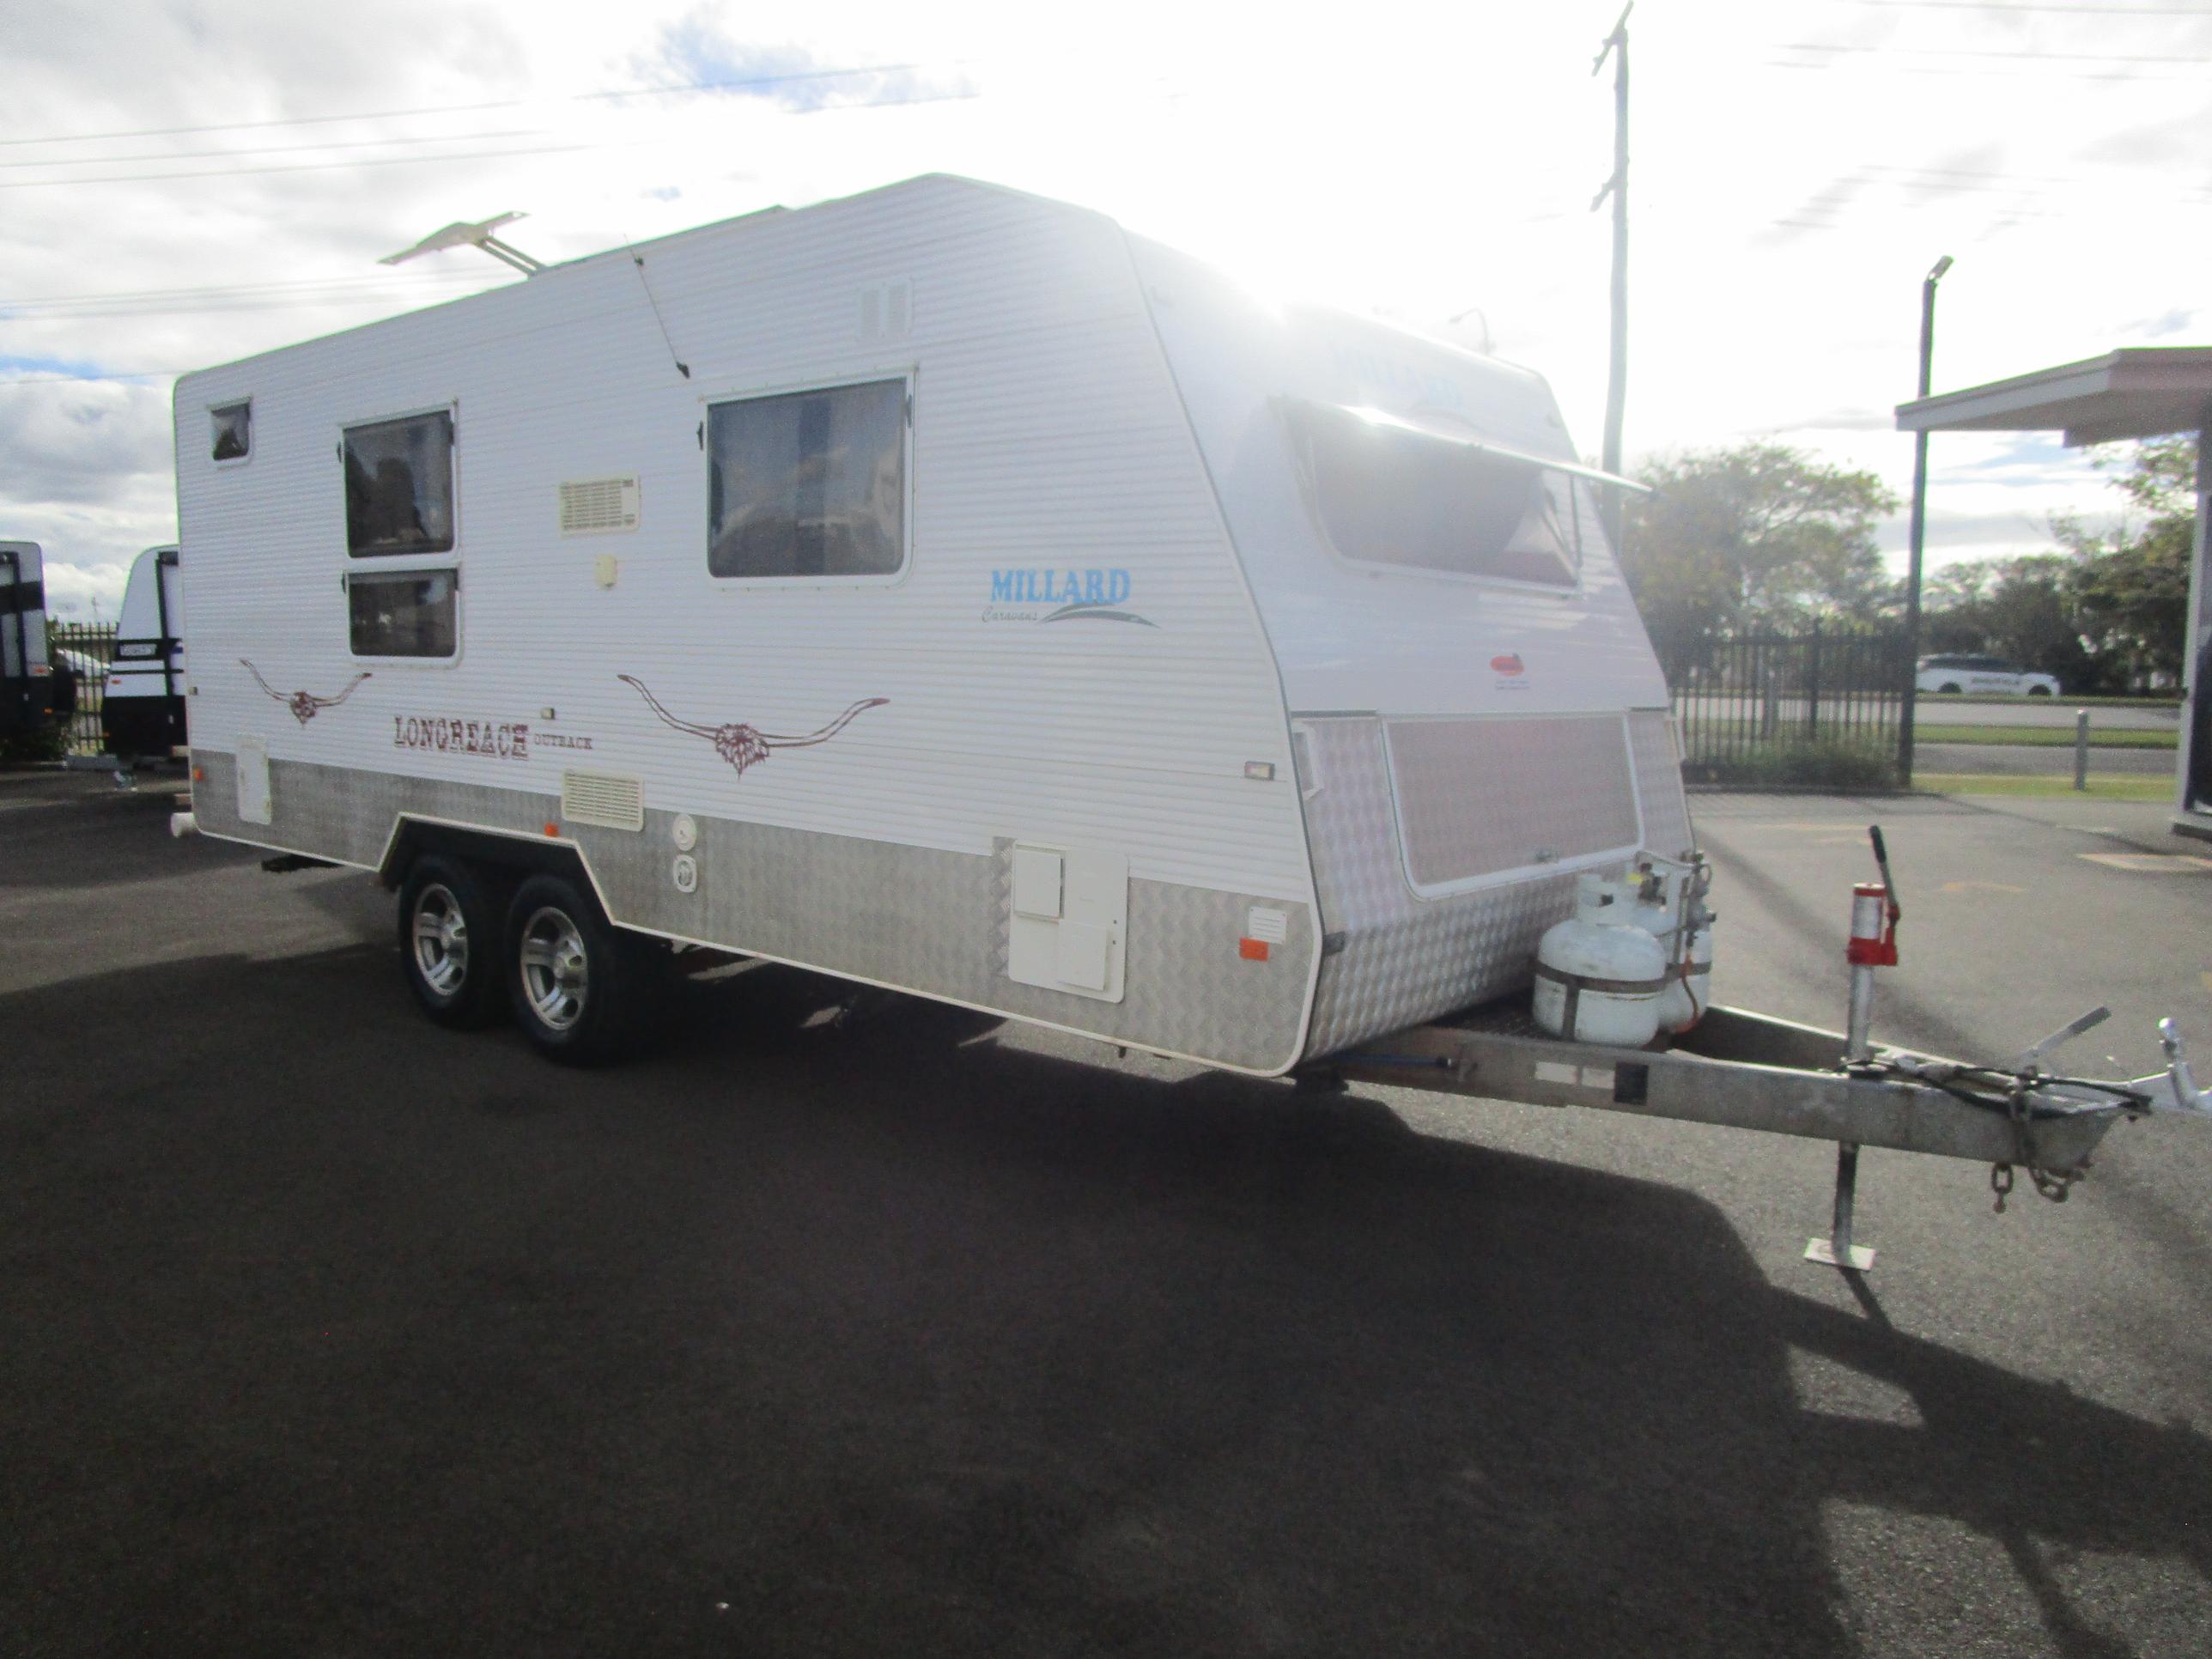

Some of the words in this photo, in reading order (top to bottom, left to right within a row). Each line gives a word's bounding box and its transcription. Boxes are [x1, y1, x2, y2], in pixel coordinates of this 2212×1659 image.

[991, 569, 1130, 604] MILLARD
[394, 716, 528, 759] LONGREACH
[534, 734, 592, 750] OUTBACK
